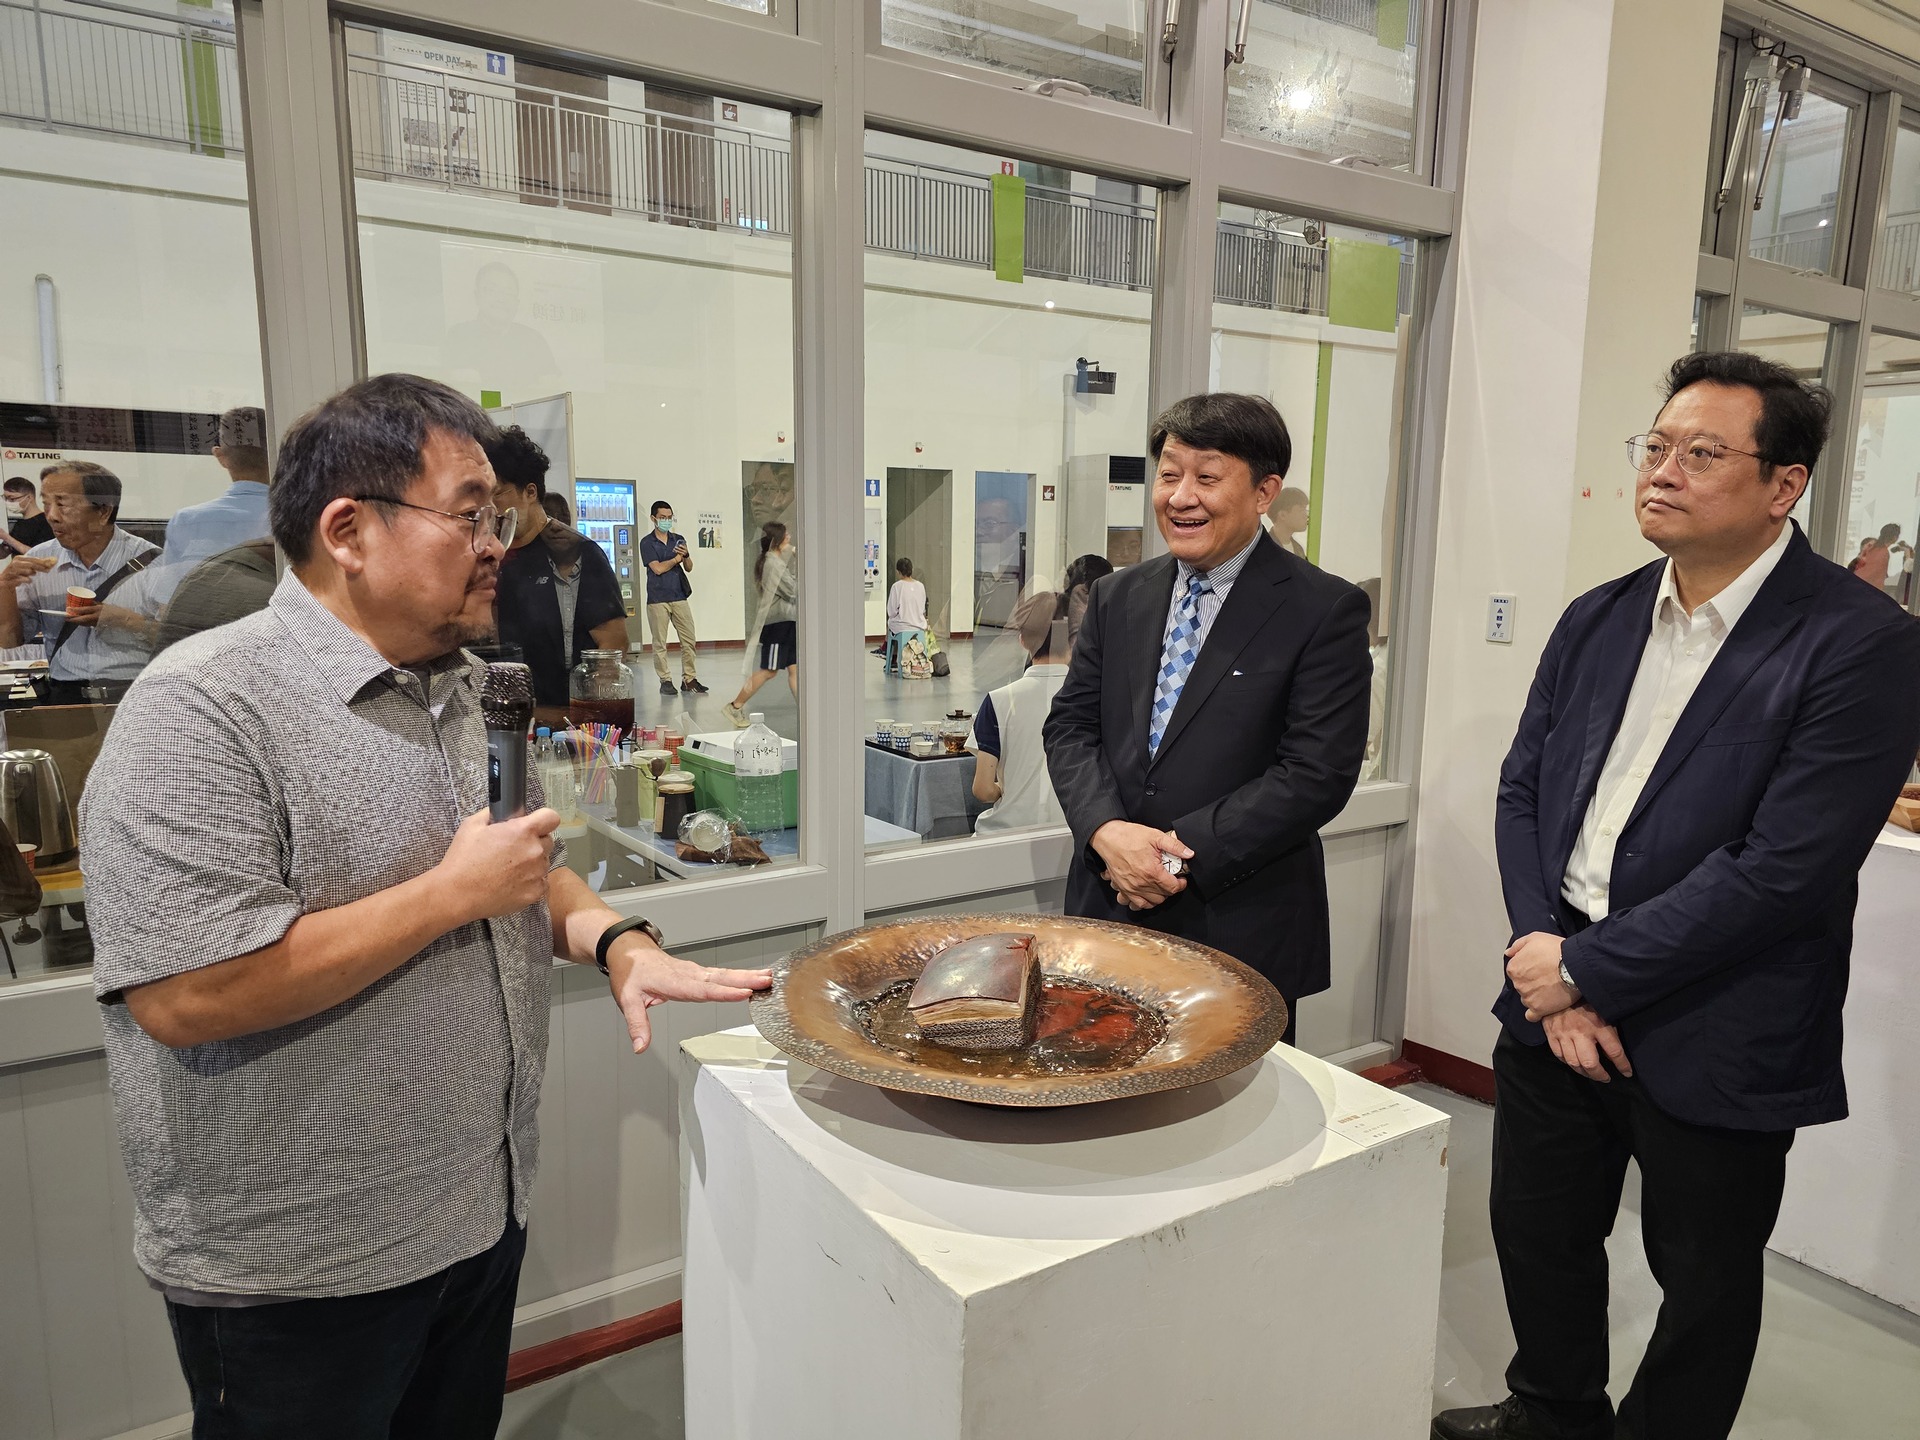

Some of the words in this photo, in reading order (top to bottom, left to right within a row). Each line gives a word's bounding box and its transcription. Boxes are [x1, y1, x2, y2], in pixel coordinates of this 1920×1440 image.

[424, 51, 444, 61] OPEN
[446, 55, 461, 64] DAY
[17, 451, 61, 460] TATUNG
